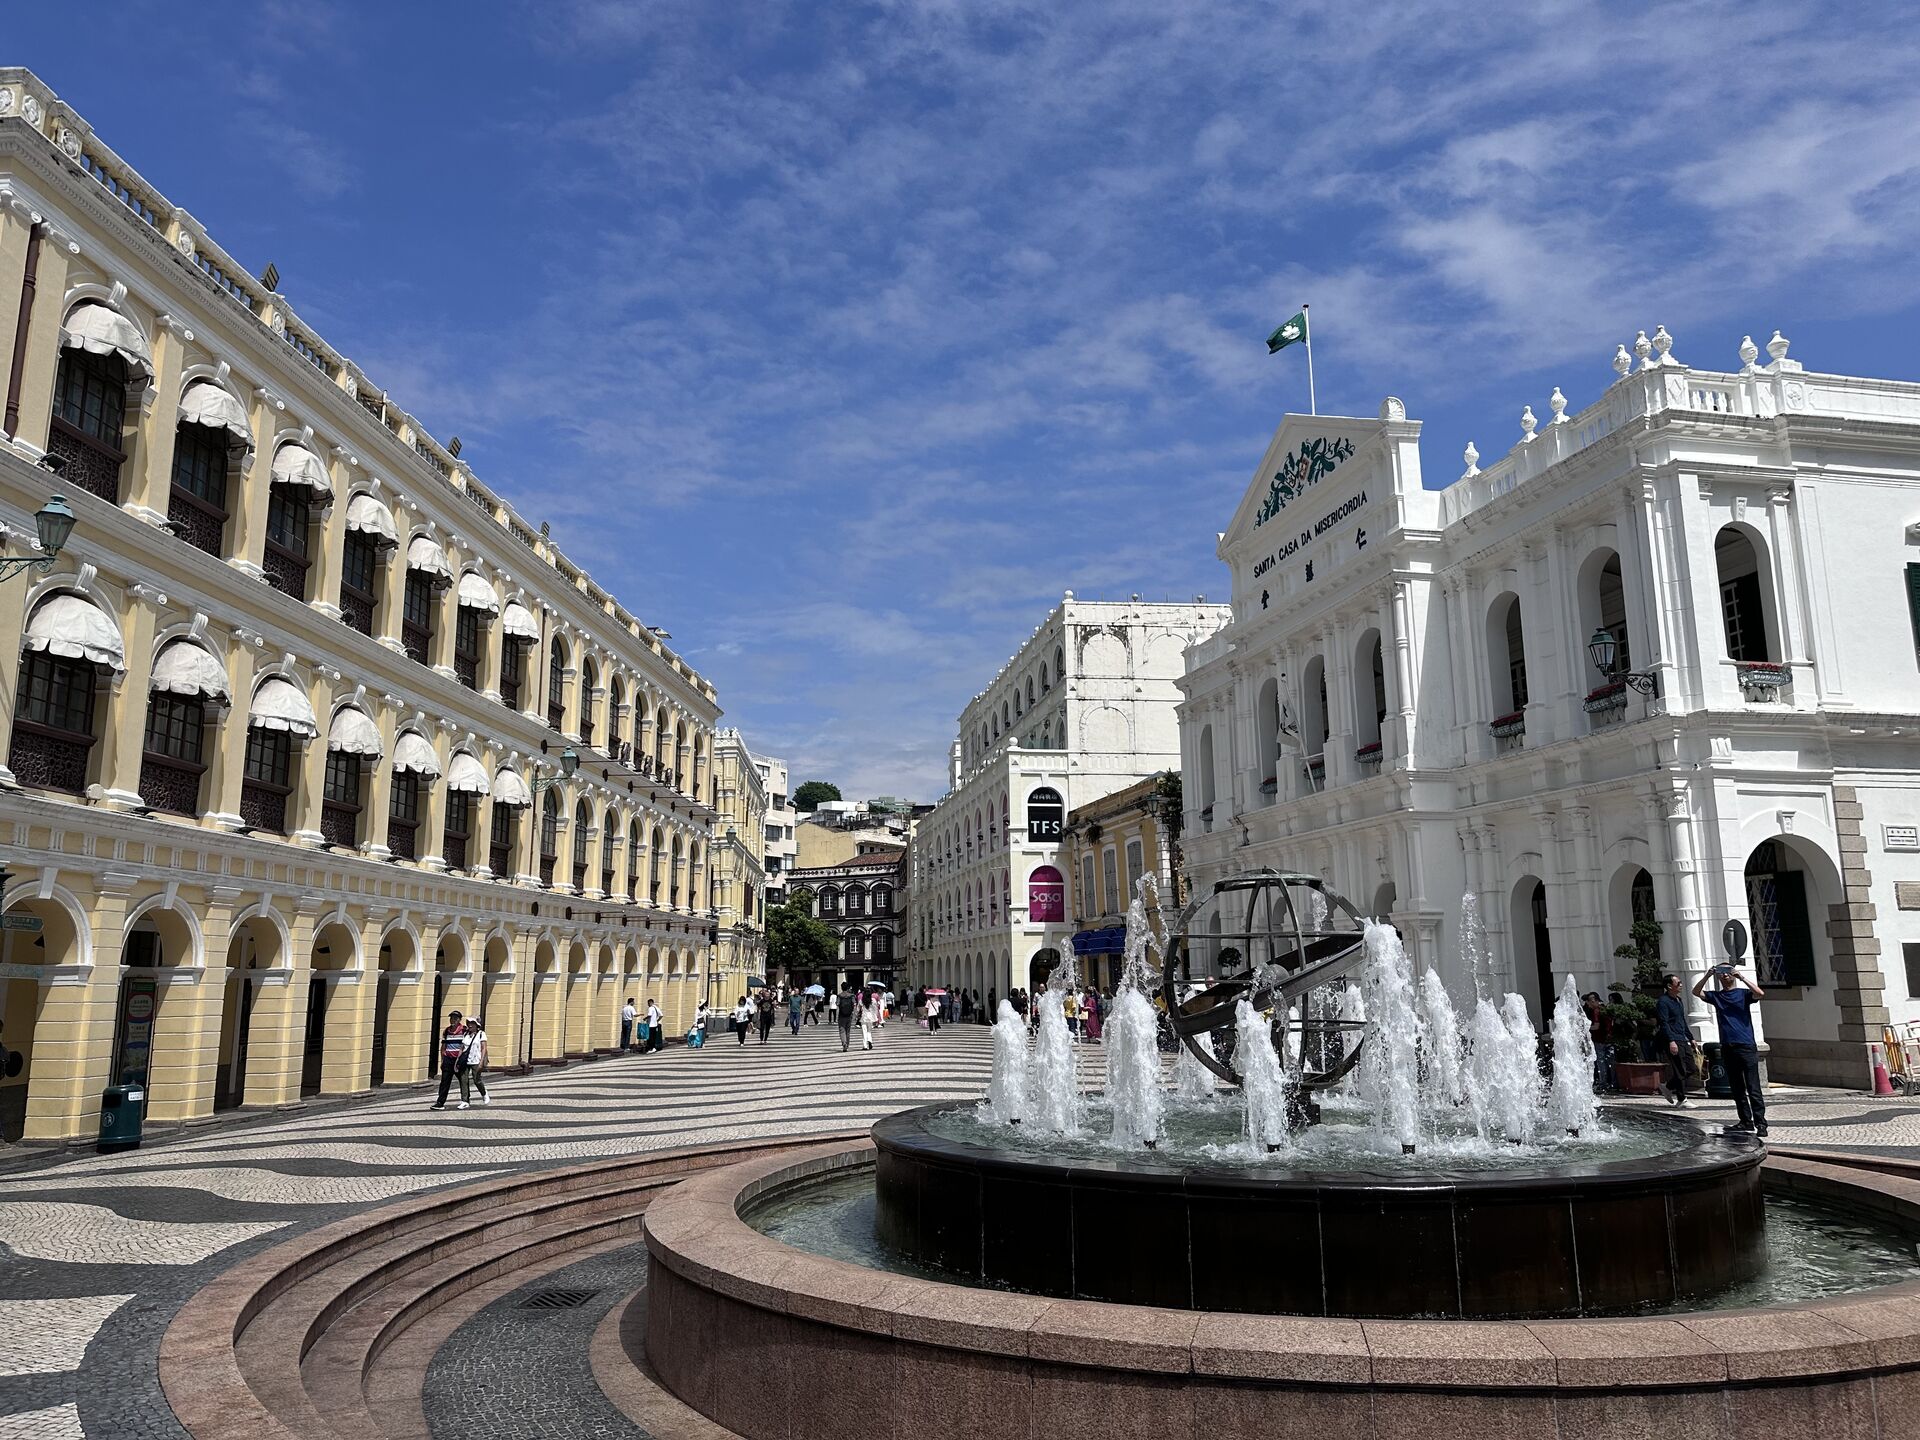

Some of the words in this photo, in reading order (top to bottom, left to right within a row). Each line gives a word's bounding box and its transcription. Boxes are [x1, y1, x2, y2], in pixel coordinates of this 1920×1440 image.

[1253, 555, 1276, 578] SANTA
[1278, 539, 1299, 561] CASA
[1301, 529, 1312, 546] DA
[1314, 490, 1368, 537] MISERICORDIA
[1031, 821, 1061, 834] TFS
